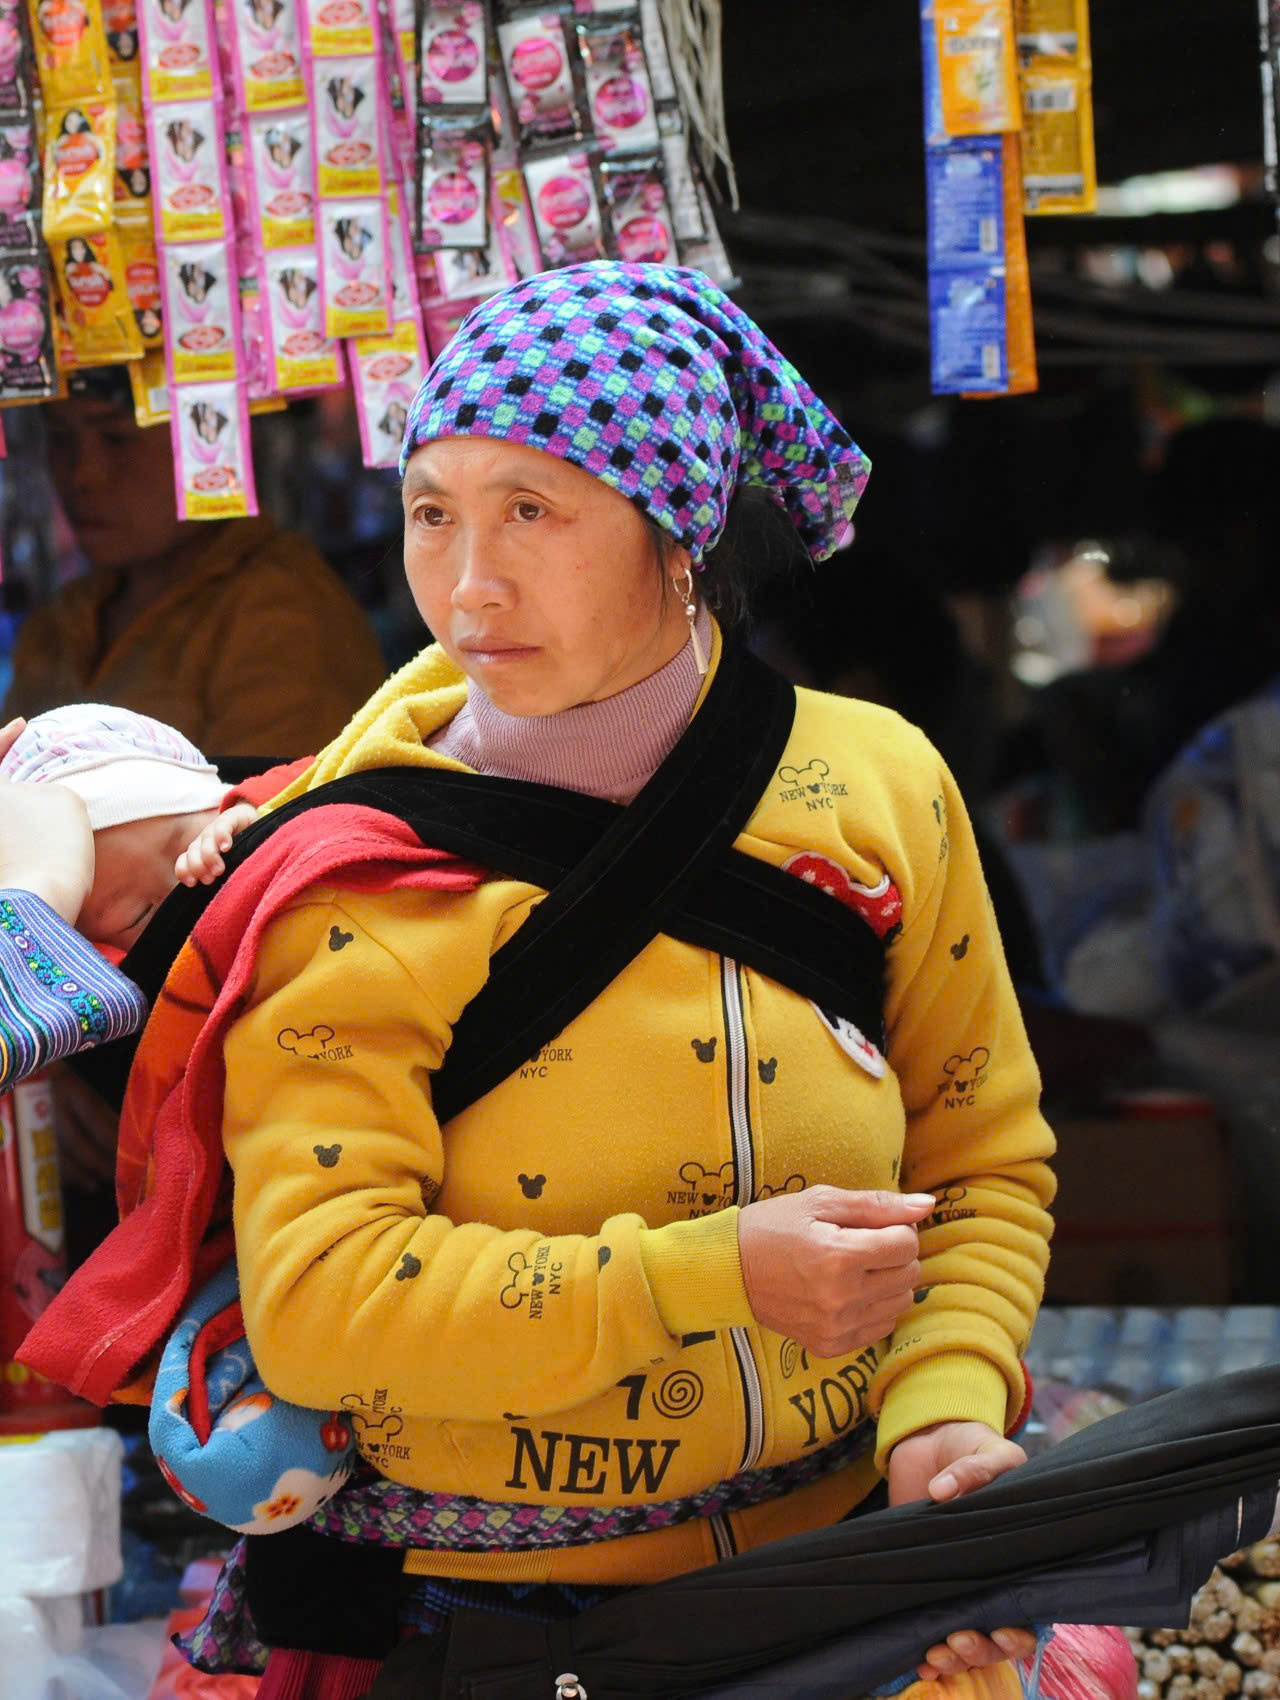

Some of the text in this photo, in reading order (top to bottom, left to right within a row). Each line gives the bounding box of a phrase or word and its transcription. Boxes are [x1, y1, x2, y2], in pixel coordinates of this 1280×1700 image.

[779, 787, 806, 802] NEW
[806, 798, 833, 811] NYC
[320, 1045, 354, 1061] YORK
[541, 1048, 573, 1061] YORK
[520, 1066, 548, 1079] NYC
[944, 1095, 976, 1109] NYC
[667, 1191, 699, 1204] NEW
[689, 1208, 719, 1219] NY
[943, 1208, 976, 1221] YORK
[528, 1245, 551, 1319] NEW YORK
[548, 1261, 563, 1295] NYC
[381, 1443, 411, 1460] YORK
[505, 1427, 680, 1494] NEW
